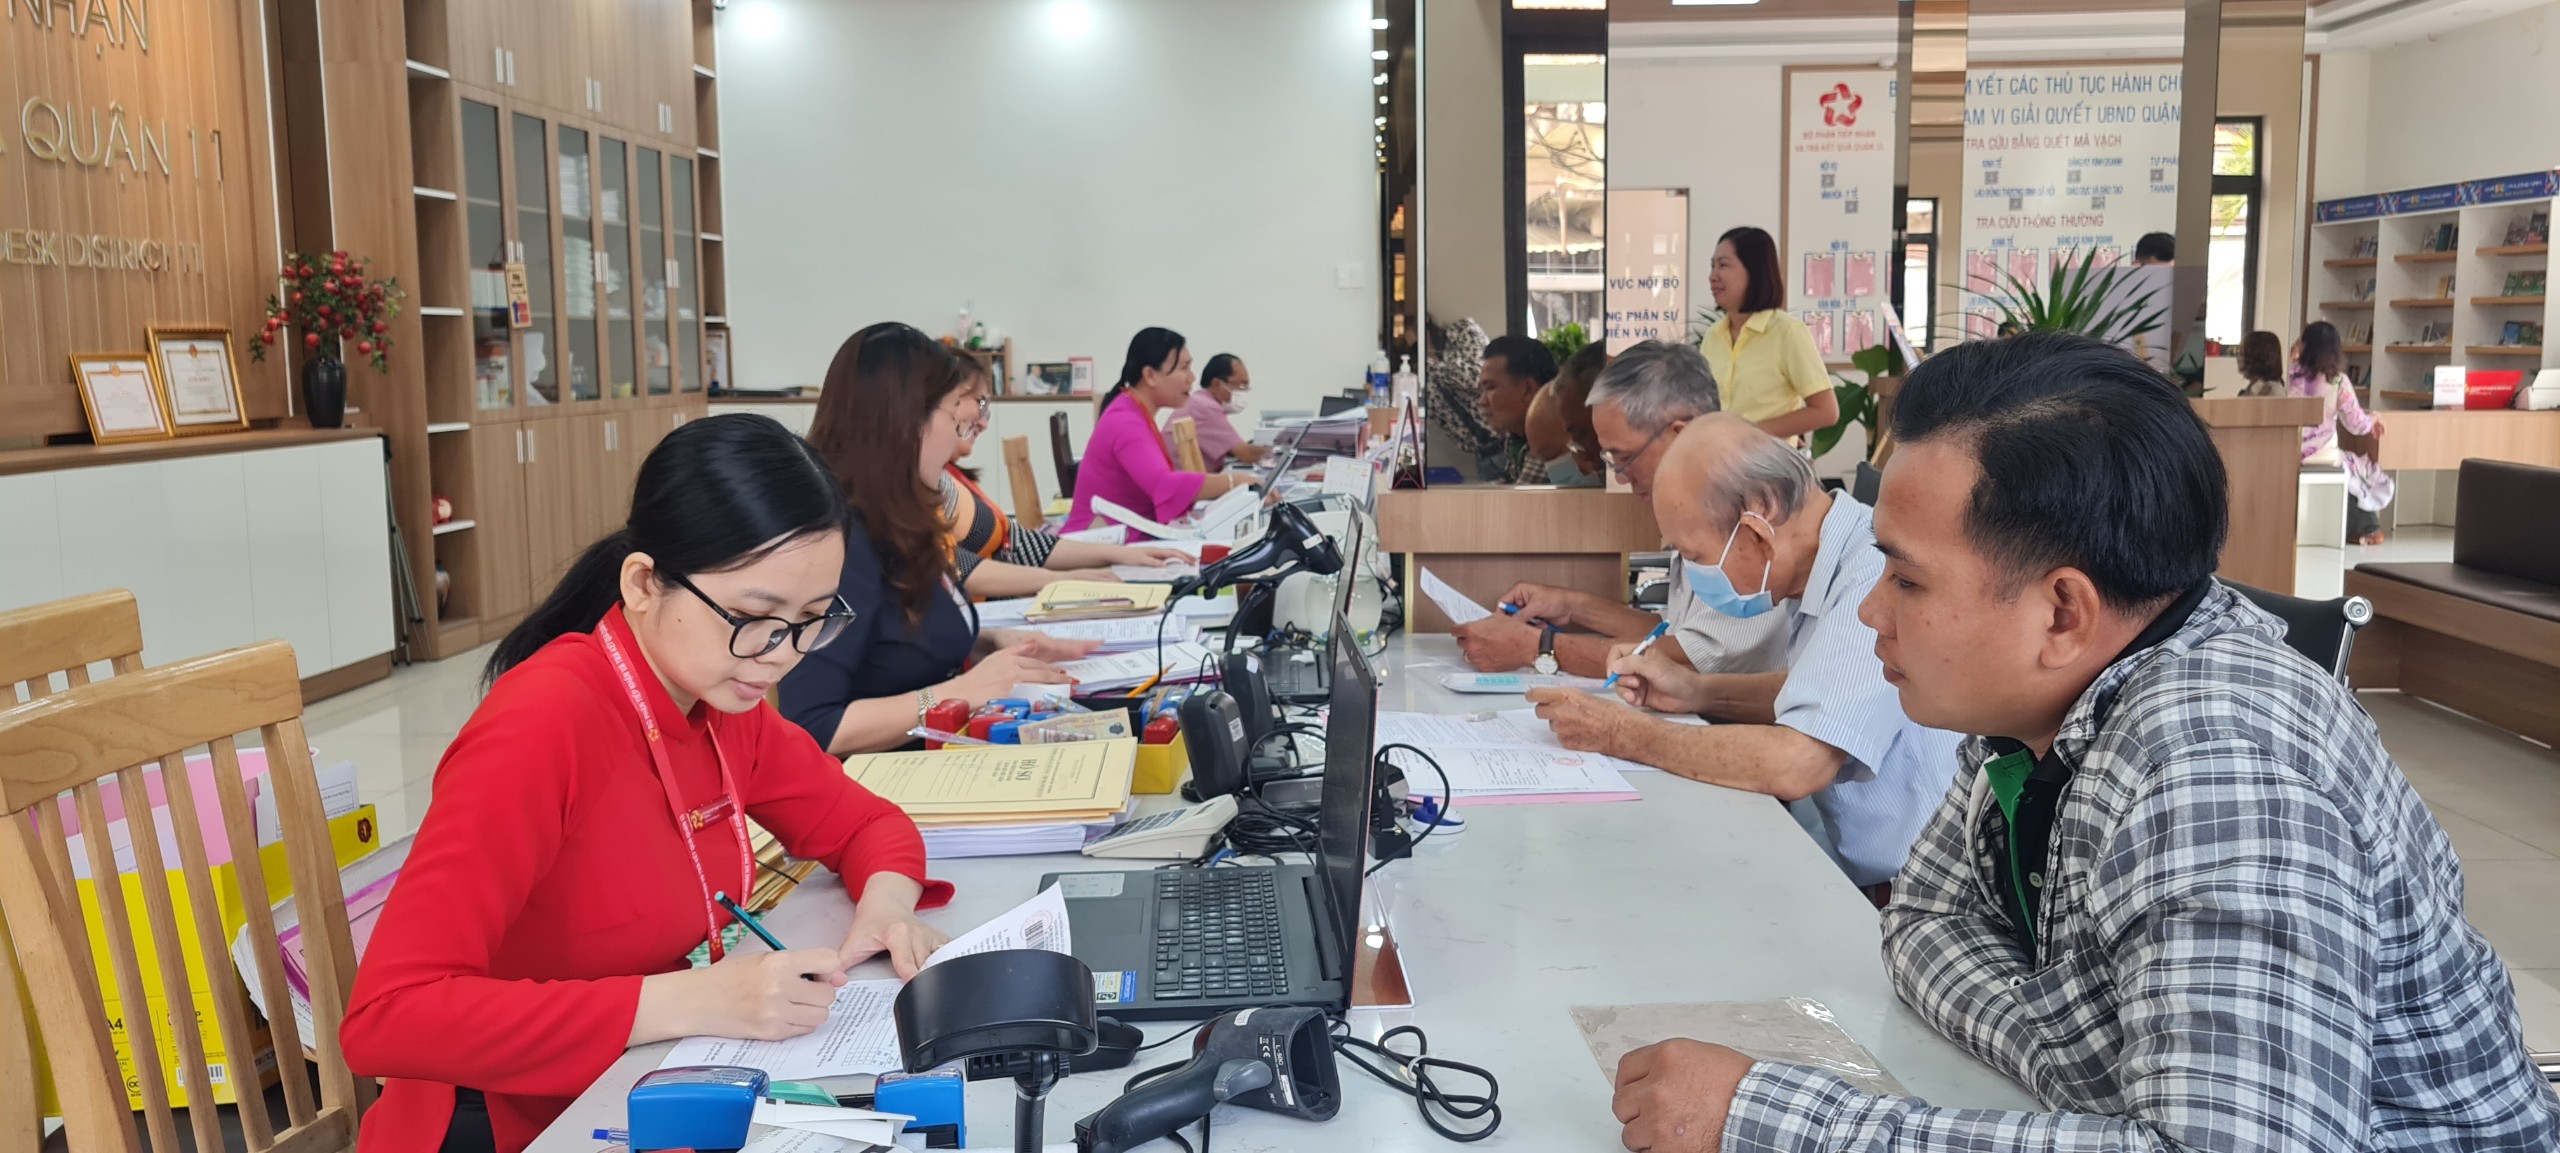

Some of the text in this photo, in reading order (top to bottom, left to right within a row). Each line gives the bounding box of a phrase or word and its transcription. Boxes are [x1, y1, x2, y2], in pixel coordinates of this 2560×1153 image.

[1977, 72, 2004, 95] YẾT
[2010, 74, 2038, 95] CÁC
[2045, 72, 2073, 94] THỦ
[2080, 76, 2106, 96] TỤC
[2112, 72, 2152, 93] HÀNH
[1992, 108, 2004, 125] VI
[2011, 102, 2040, 125] GIẢI
[2045, 100, 2092, 125] QUYẾT
[2098, 106, 2136, 124] UBND
[2142, 102, 2180, 126] QUẬN
[22, 96, 224, 185] QUẬN 11
[1966, 138, 1985, 149] TRA
[1976, 216, 1996, 229] TRA
[0, 228, 57, 267] ESK
[66, 233, 170, 273] DISTRICT
[1609, 275, 1680, 291] VỰC NỘI BỘ
